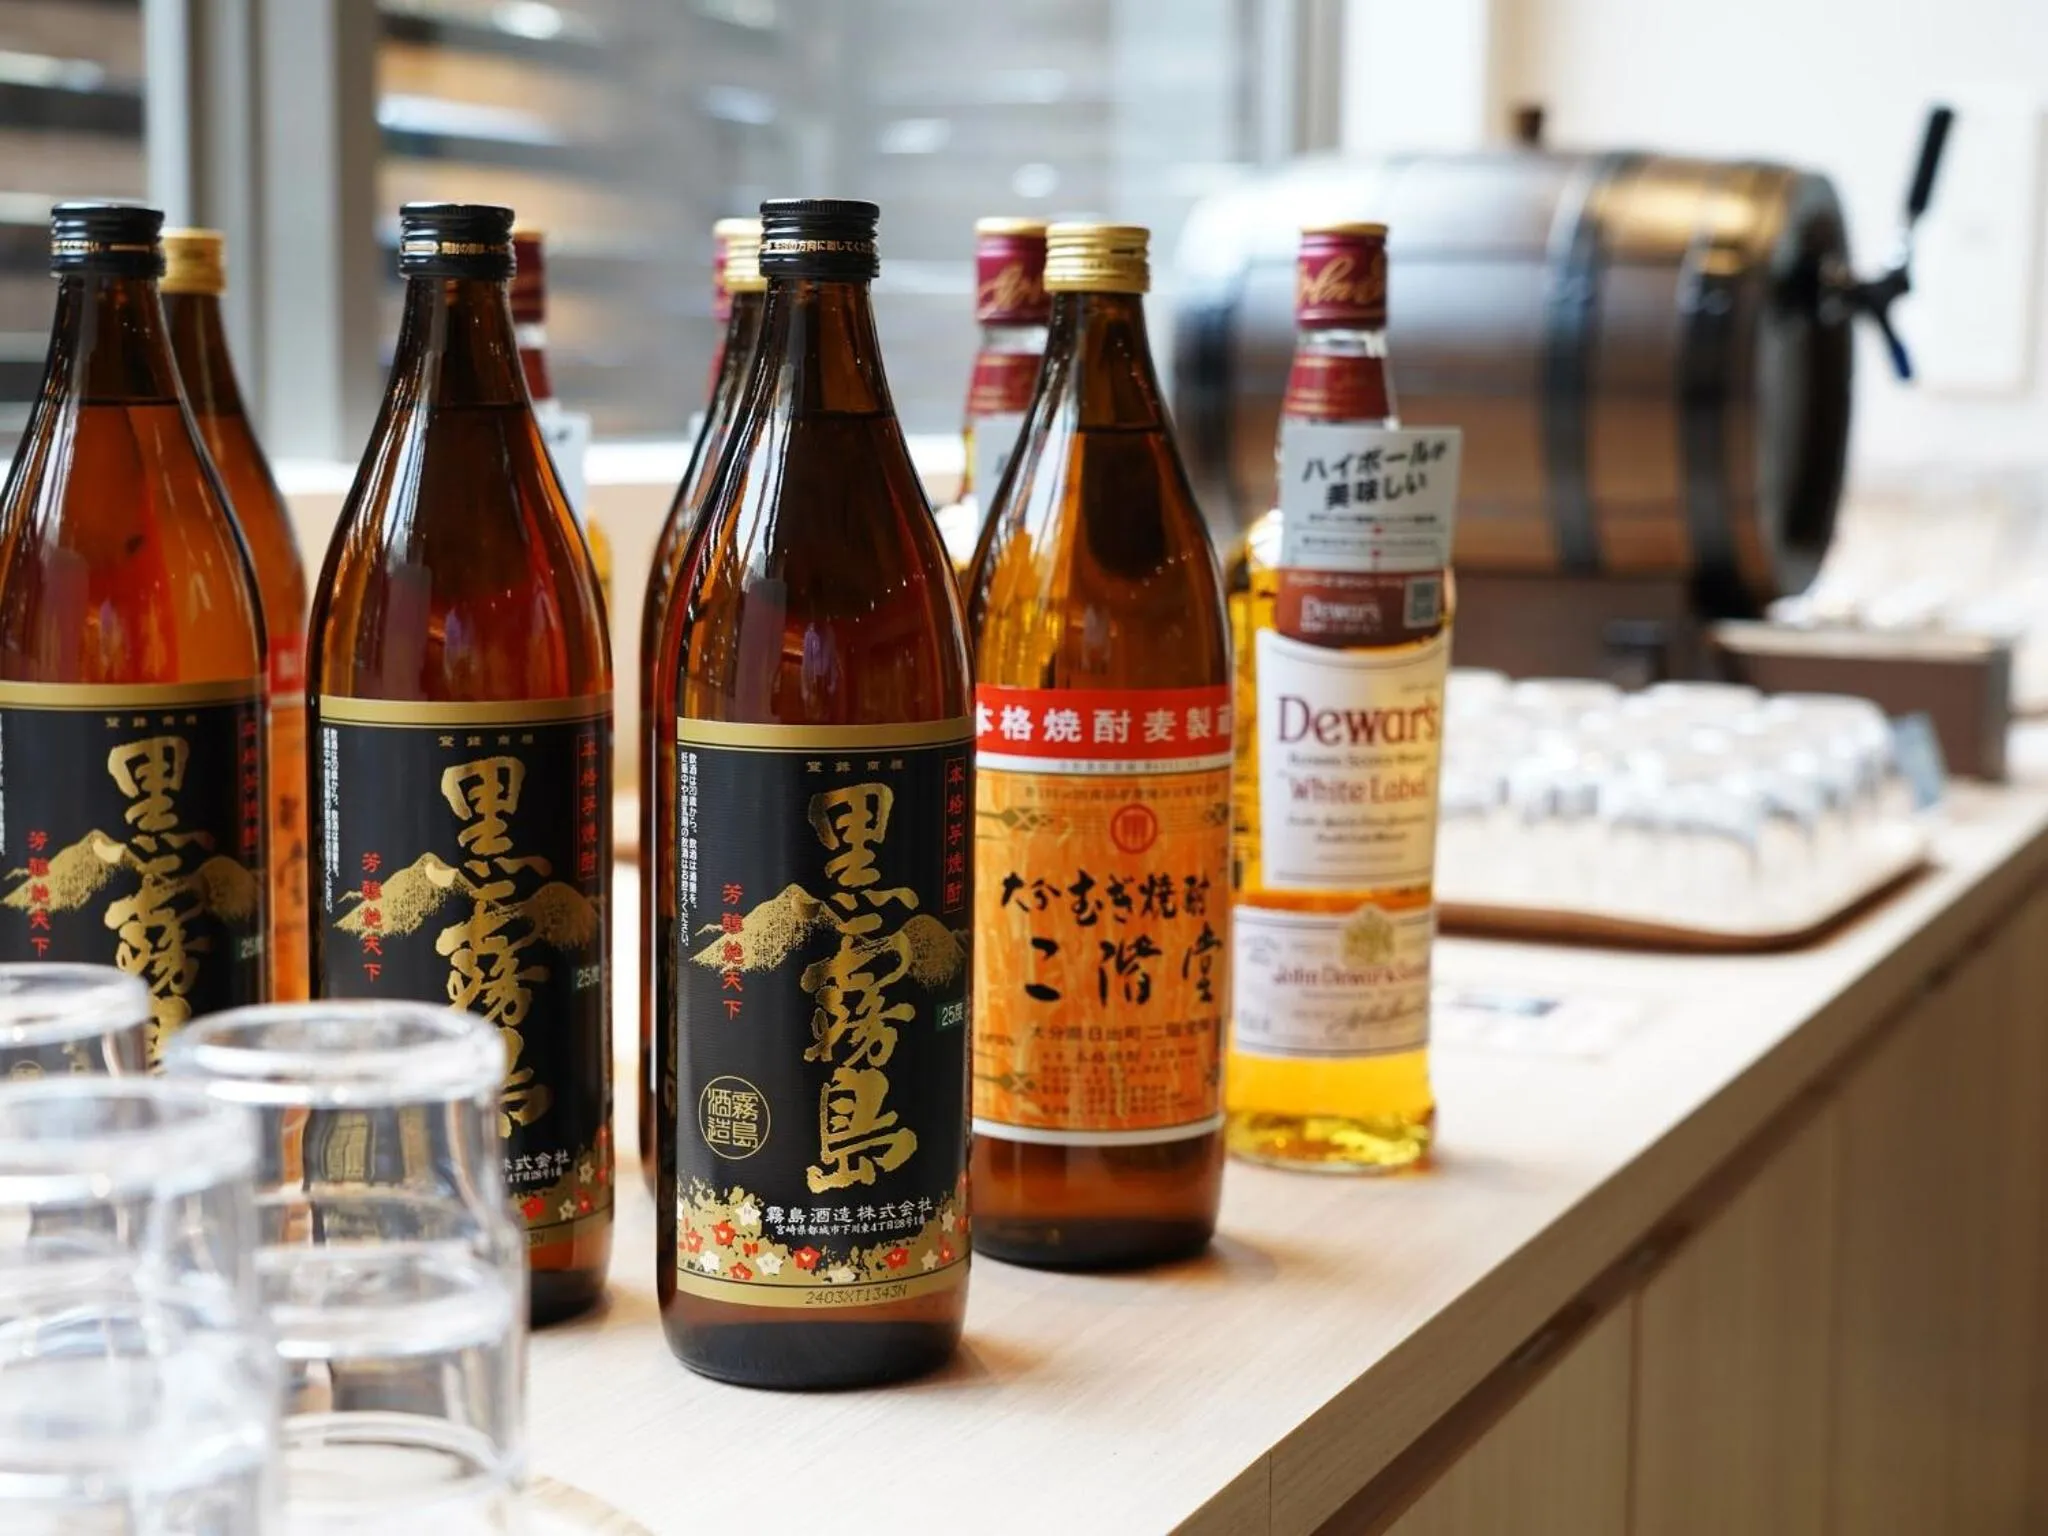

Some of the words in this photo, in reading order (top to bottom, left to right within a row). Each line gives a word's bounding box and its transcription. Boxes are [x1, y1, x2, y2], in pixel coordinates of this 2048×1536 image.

[1277, 694, 1440, 748] Dewar's
[800, 783, 919, 1194] 黒霧島
[1025, 921, 1222, 1007] 二階堂
[765, 1196, 933, 1224] 霧島酒造株式会社
